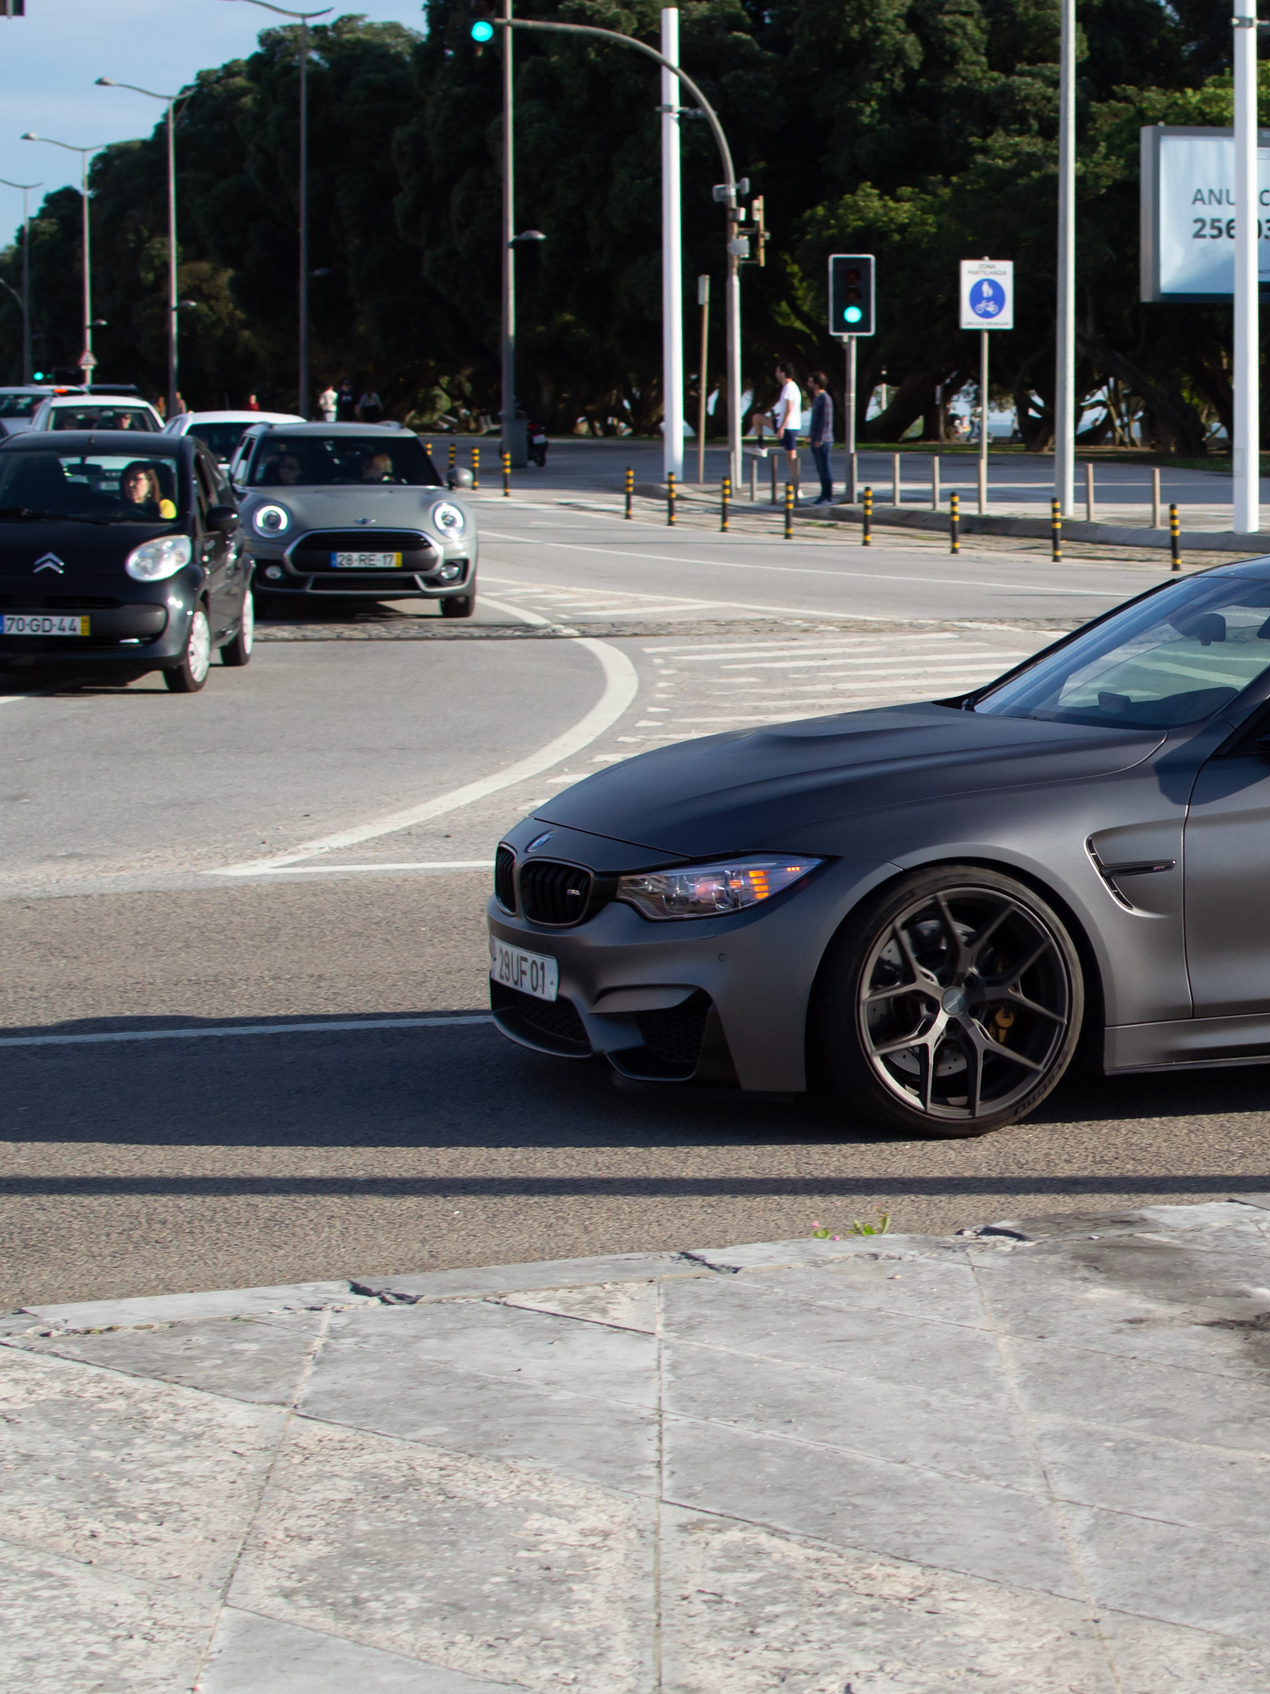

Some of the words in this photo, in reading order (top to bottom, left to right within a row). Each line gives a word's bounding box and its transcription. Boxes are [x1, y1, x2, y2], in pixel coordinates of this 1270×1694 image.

[1192, 217, 1236, 239] 256
[338, 554, 394, 566] 28-RE-17
[6, 617, 77, 633] 70-GD-44
